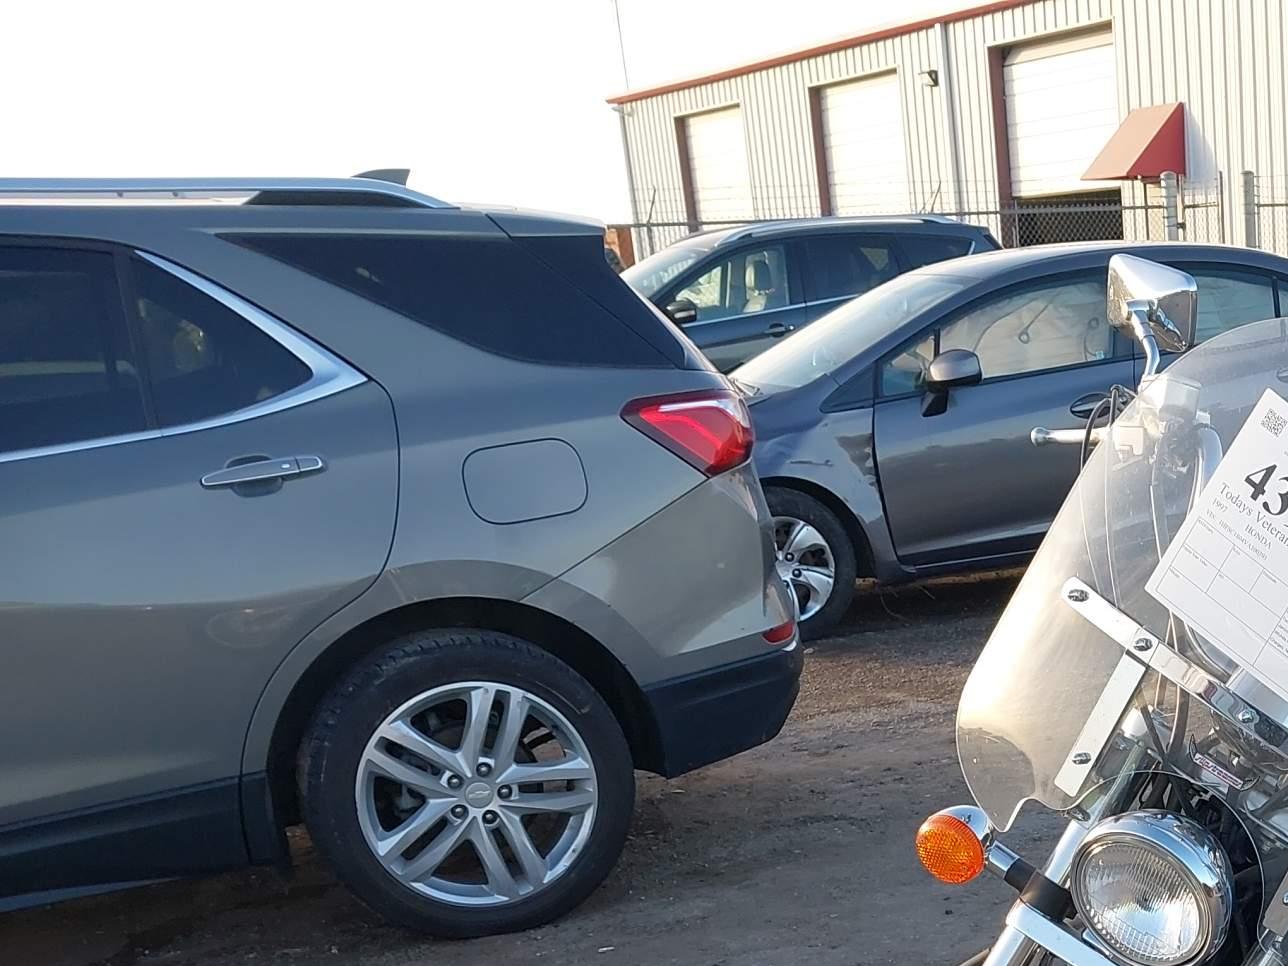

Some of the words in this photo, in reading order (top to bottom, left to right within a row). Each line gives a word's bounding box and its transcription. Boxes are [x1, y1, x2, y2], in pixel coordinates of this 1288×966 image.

[1219, 482, 1254, 517] Todays
[1212, 498, 1229, 513] 1997
[1244, 523, 1272, 550] HONDA
